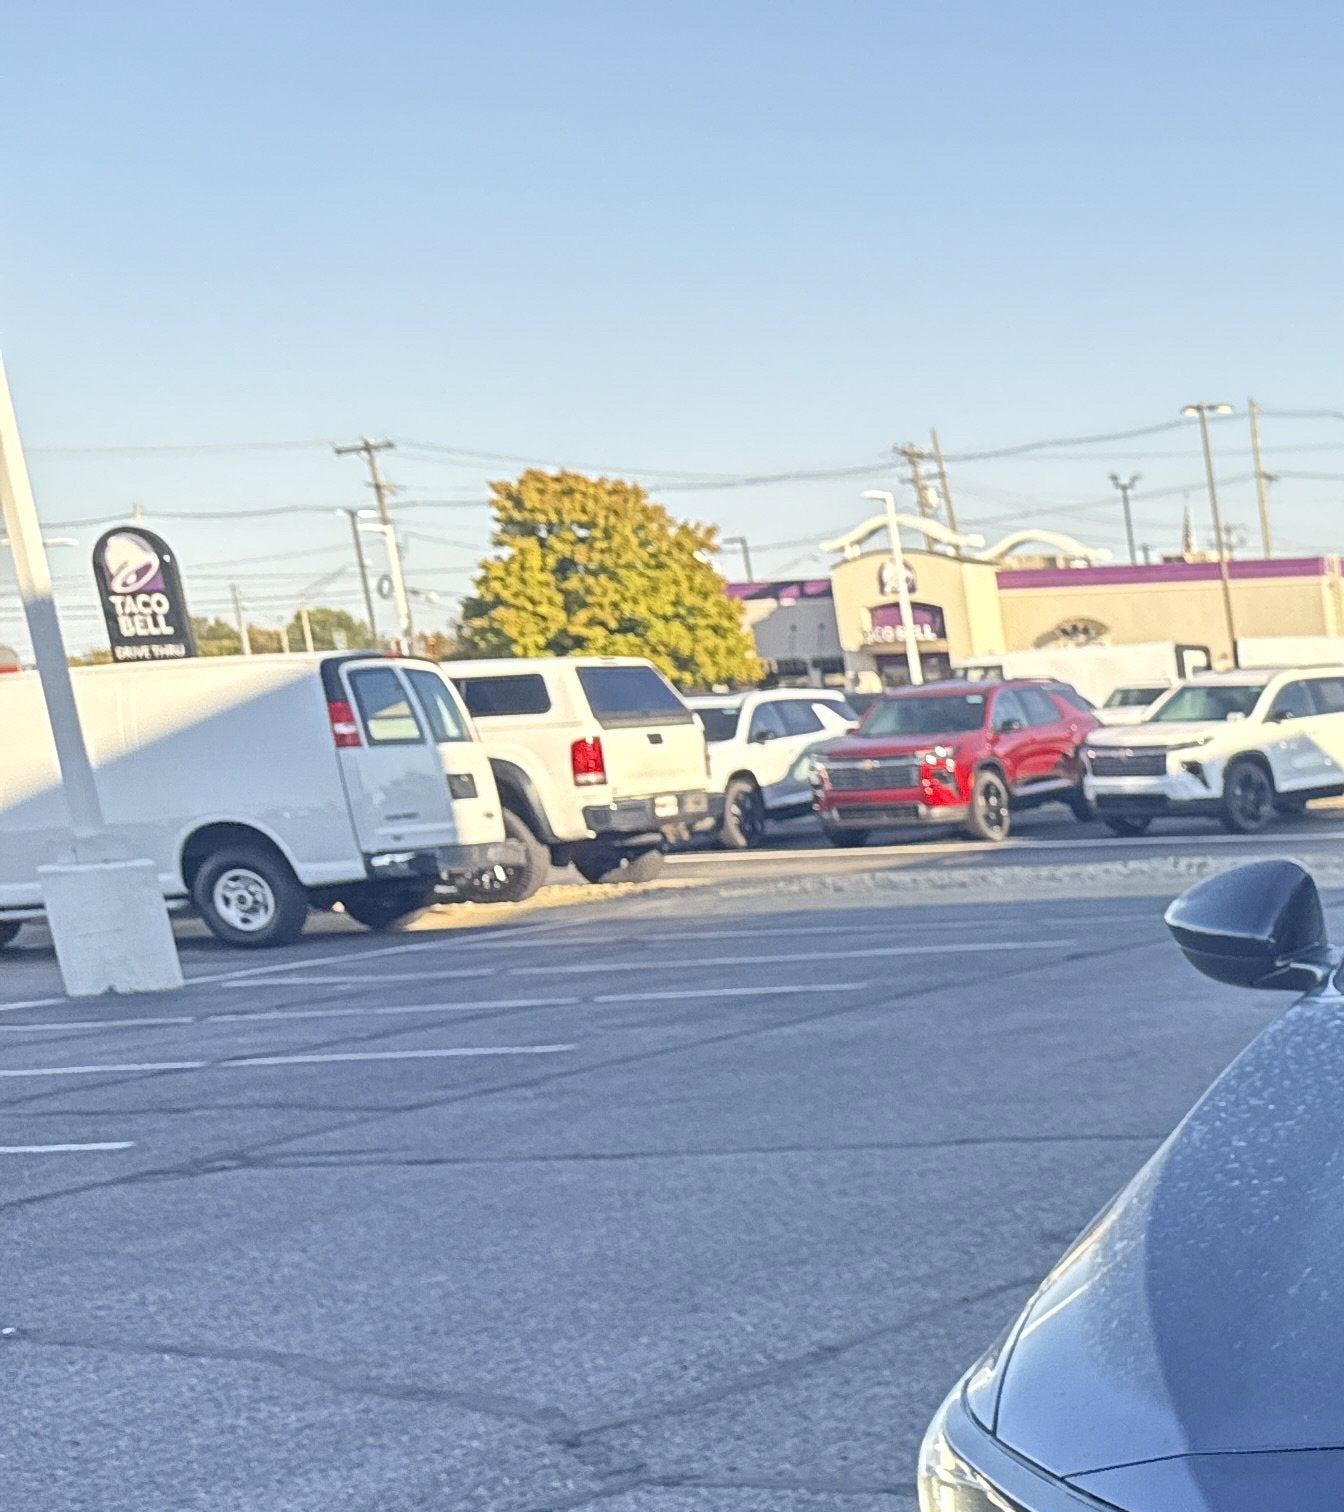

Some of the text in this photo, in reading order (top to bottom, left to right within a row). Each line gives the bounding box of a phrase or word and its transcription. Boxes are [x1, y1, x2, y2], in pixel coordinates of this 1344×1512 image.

[109, 592, 170, 616] TACO
[117, 614, 175, 637] BELL
[114, 644, 186, 660] DRIVE THRU
